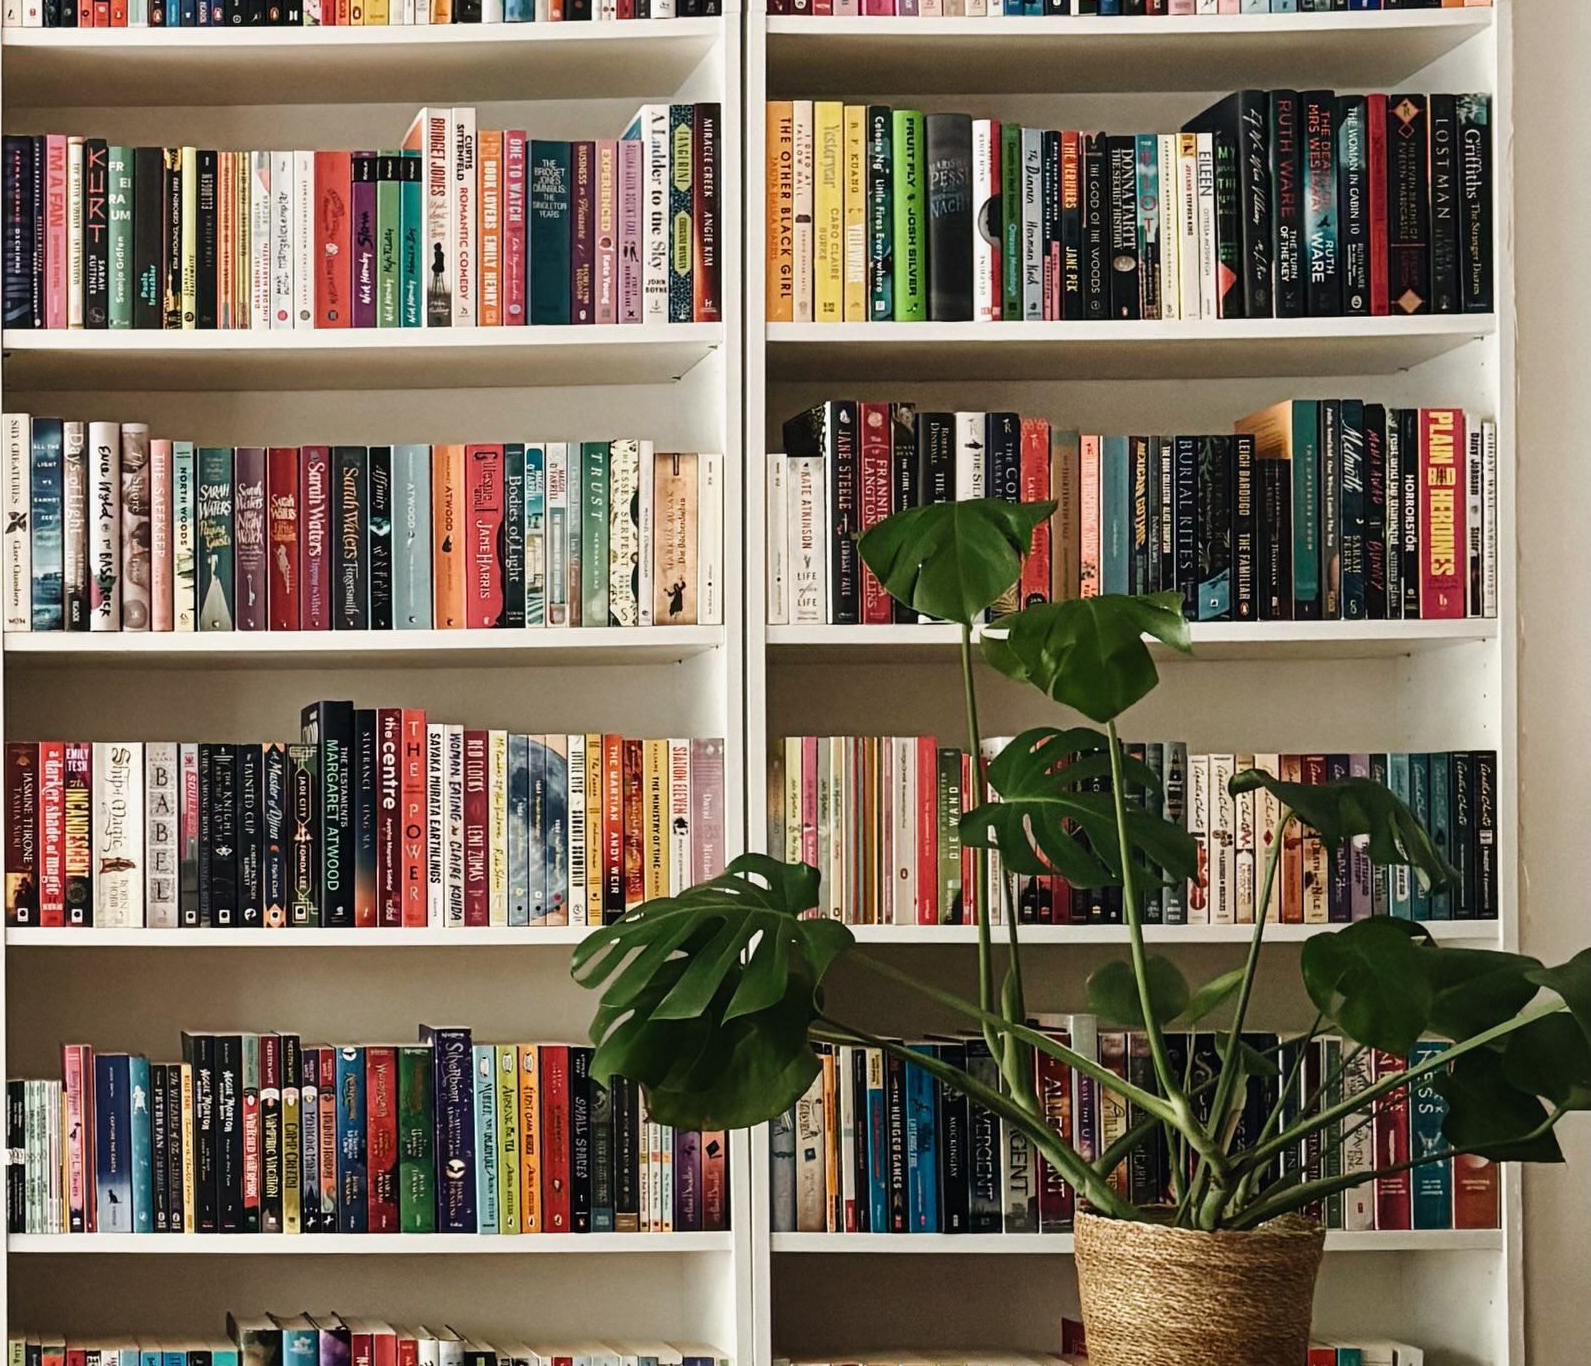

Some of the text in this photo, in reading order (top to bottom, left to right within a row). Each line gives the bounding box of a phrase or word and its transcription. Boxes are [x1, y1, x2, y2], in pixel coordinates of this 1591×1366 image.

[90, 148, 106, 243] KURT
[430, 118, 446, 196] BRIDGET JONES
[1122, 149, 1136, 249] DONNA TARTT
[460, 187, 468, 299] ROMANTIC COMEDY
[780, 118, 792, 298] THE OTHER BLACK GIRL
[1429, 412, 1454, 463] PLAIN
[592, 453, 602, 521] TRUST
[1179, 441, 1192, 568] BURIAL RITES
[1406, 475, 1418, 551] HORRORSTÖR
[1430, 489, 1455, 575] HEROINES
[383, 717, 399, 809] the centre
[406, 721, 422, 900] THE POWER
[430, 733, 440, 883] SAYAKA MURATA EARTHLINGS
[156, 768, 170, 900] BABEL
[326, 740, 339, 890] MARGARET ATWOOD
[575, 1097, 588, 1178] SMALL SPACES
[892, 1107, 902, 1189] HUNGER GAMES
